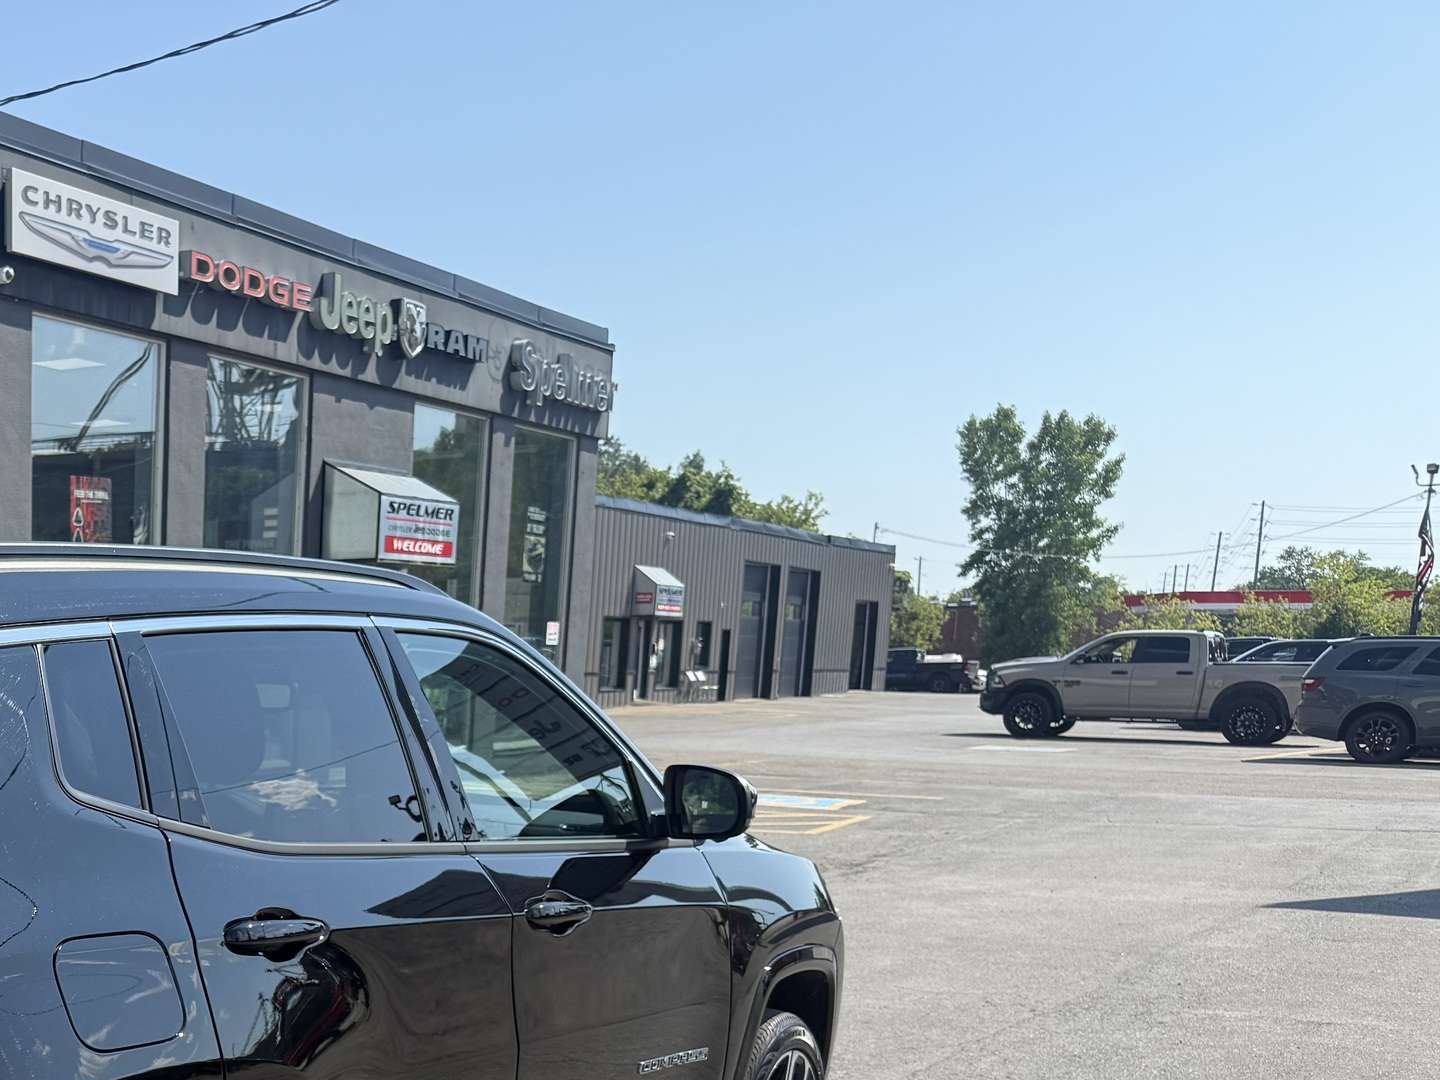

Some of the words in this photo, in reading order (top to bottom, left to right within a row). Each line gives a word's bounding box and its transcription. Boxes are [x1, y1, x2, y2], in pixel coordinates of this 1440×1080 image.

[20, 184, 173, 248] CHRYSLER
[190, 251, 314, 312] DODGE
[316, 271, 394, 357] Jeep
[427, 322, 489, 363] RAM
[386, 501, 454, 521] SPELMER
[392, 538, 444, 555] WELCOME
